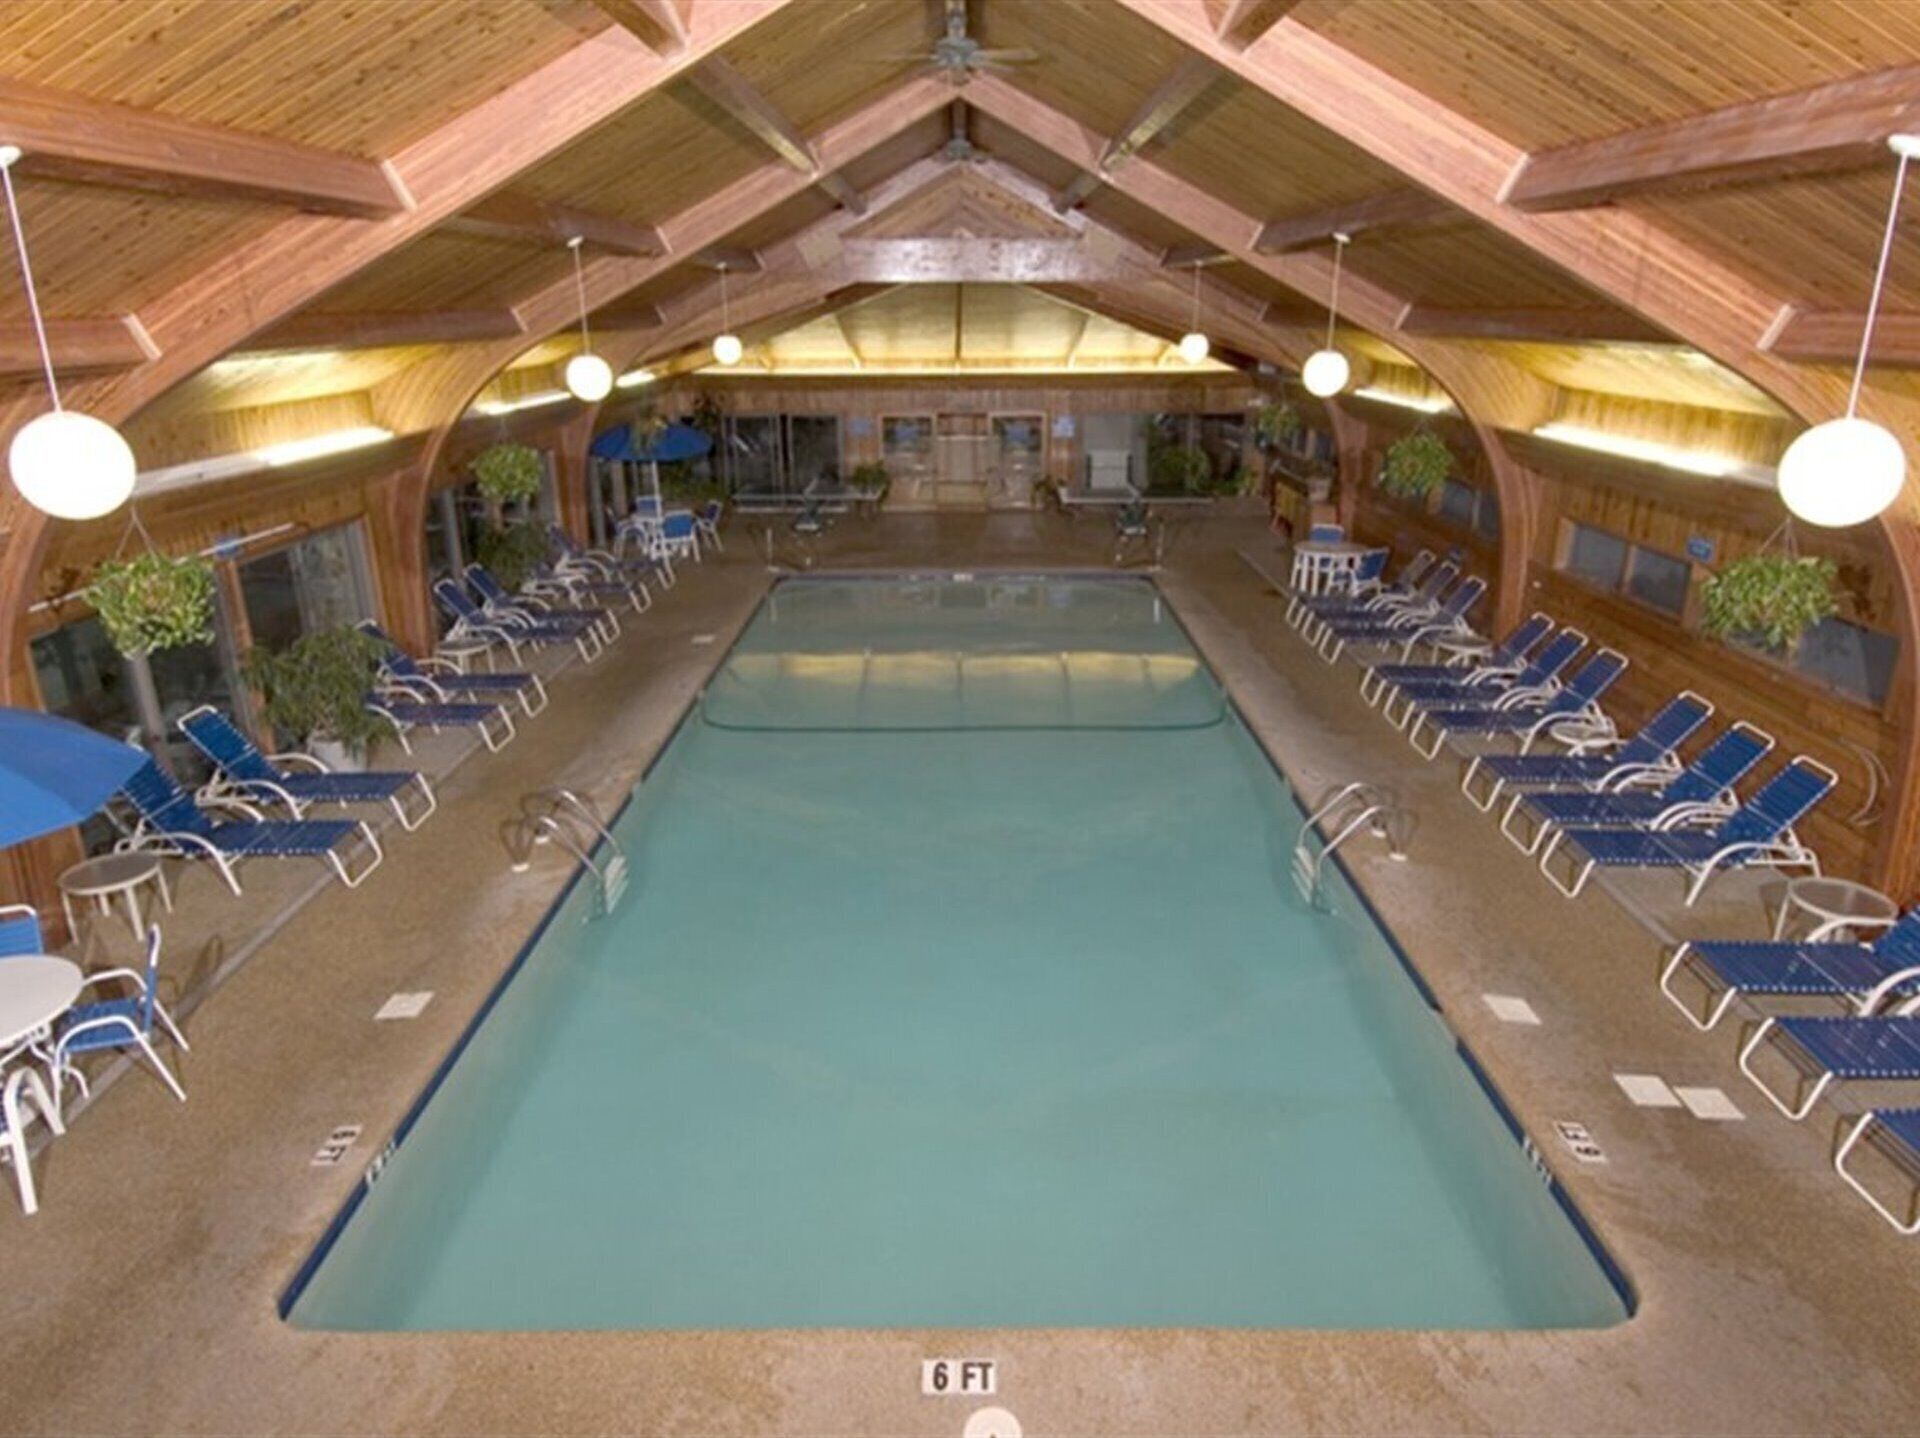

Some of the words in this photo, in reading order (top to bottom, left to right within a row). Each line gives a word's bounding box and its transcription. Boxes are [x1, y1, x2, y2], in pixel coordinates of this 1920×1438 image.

[331, 1130, 356, 1140] 6
[1575, 1146, 1601, 1156] 6
[932, 1362, 949, 1391] 6
[961, 1362, 994, 1391] FT
